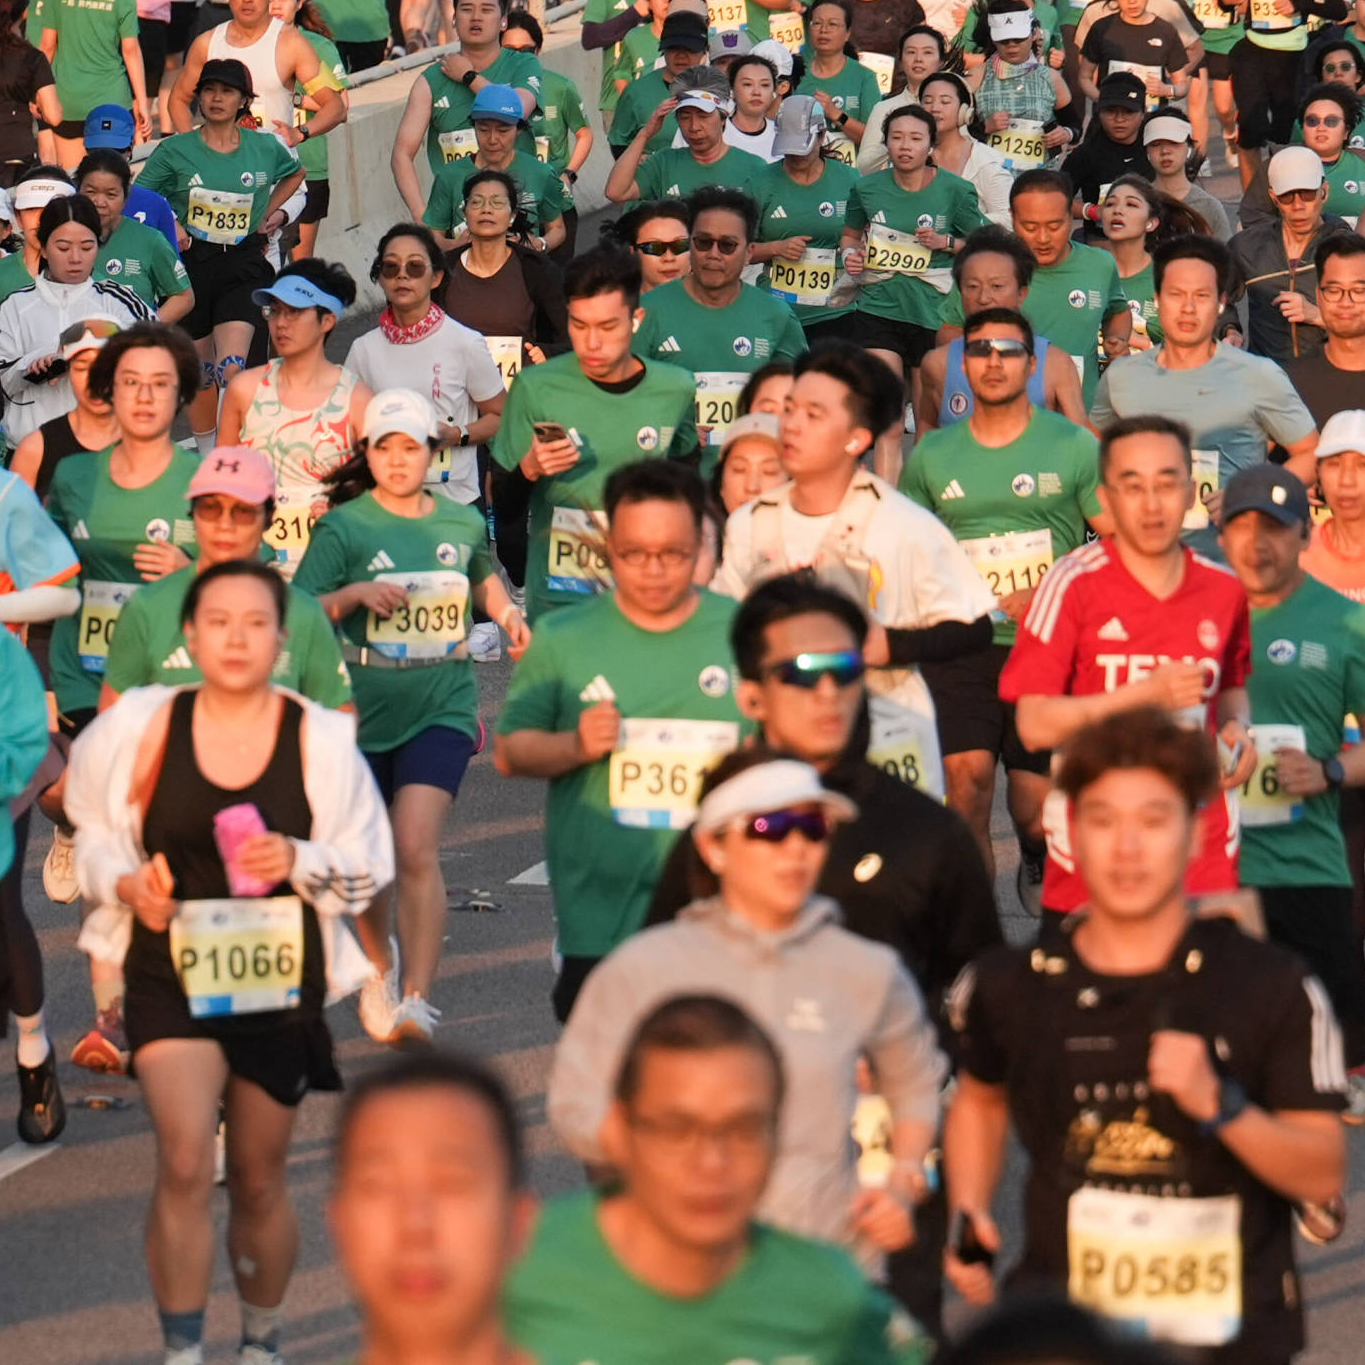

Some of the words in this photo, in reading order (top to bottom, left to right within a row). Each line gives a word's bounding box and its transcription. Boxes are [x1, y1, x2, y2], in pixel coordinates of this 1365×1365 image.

[708, 5, 743, 21] 3137
[772, 30, 803, 44] 530
[991, 135, 1043, 157] P1256
[192, 205, 247, 230] P1833
[868, 246, 926, 269] P2990
[775, 267, 830, 289] P0139
[432, 363, 441, 400] CAN
[695, 401, 733, 423] 120
[986, 563, 1049, 596] 2118
[619, 763, 710, 795] P361
[180, 944, 295, 983] P1066
[1084, 1248, 1230, 1299] P0585
